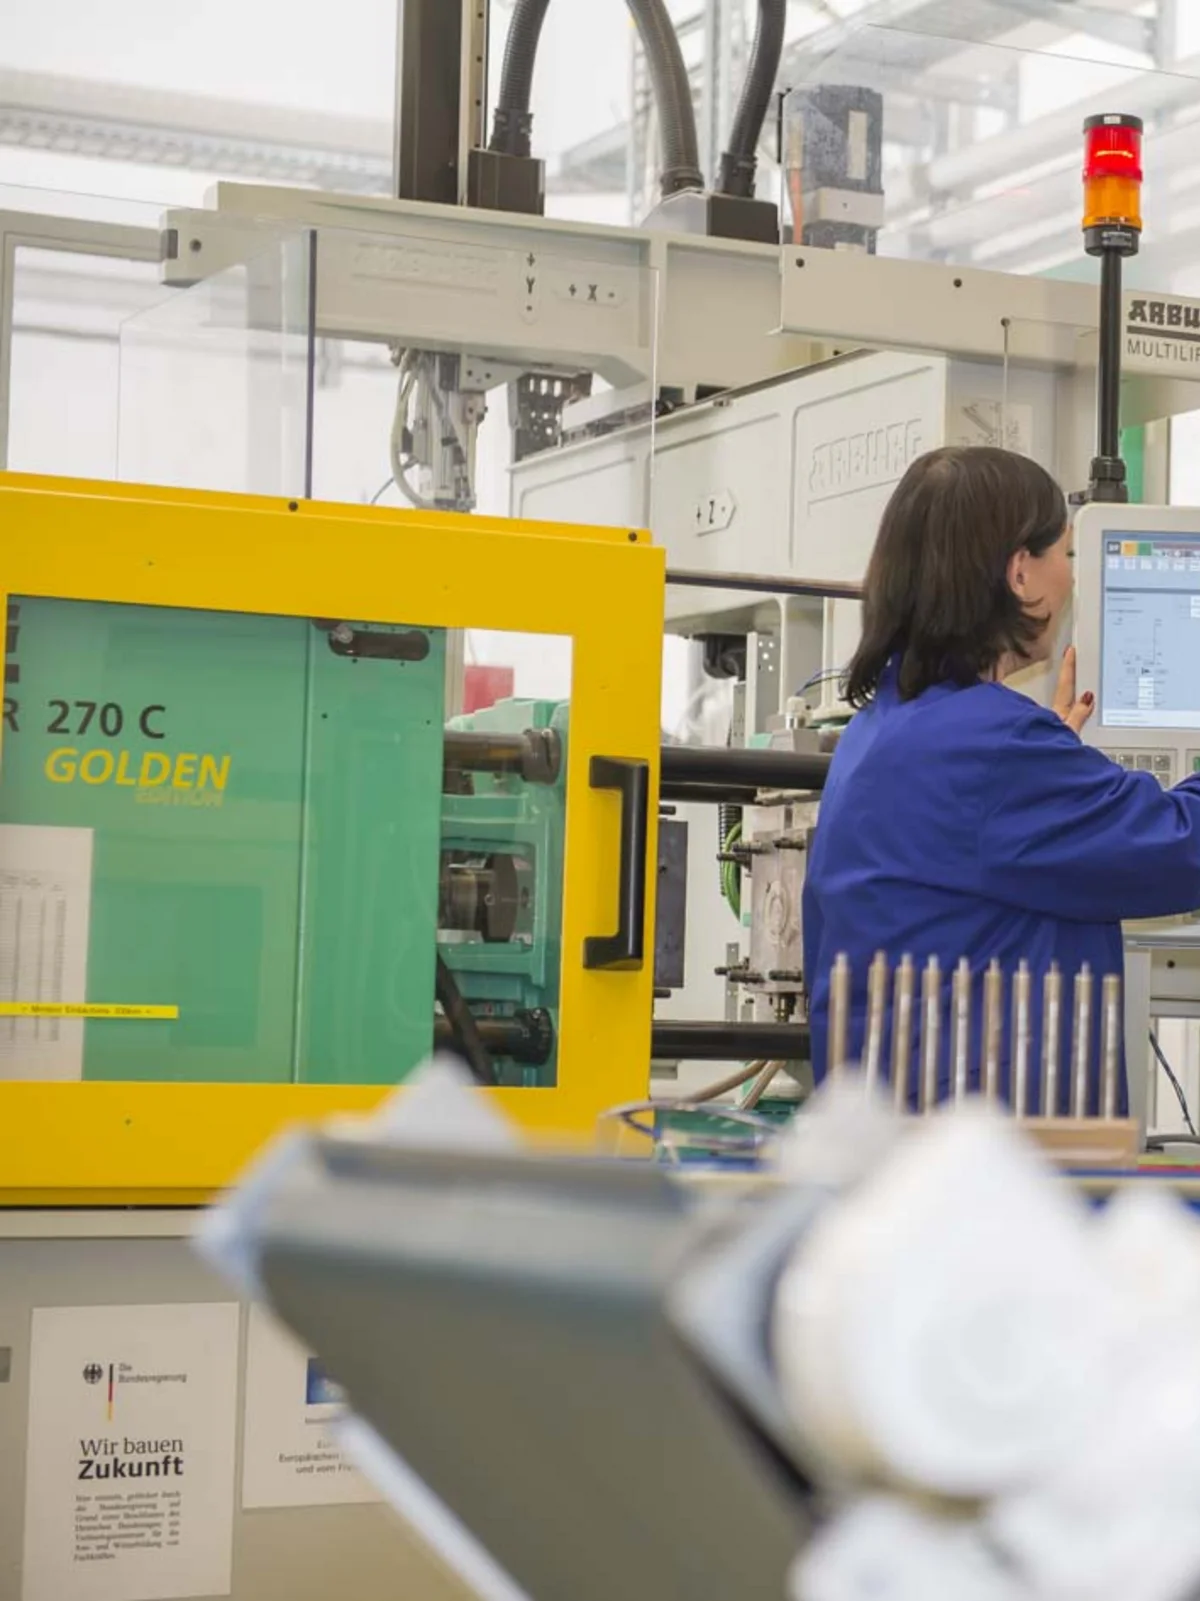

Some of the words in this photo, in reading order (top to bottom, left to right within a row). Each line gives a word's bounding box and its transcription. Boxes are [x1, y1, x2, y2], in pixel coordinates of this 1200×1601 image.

[47, 700, 123, 737] 270
[139, 705, 166, 739] C
[44, 747, 232, 793] GOLDEN
[80, 1439, 118, 1456] Wir
[123, 1437, 183, 1454] bauen
[78, 1455, 184, 1480] Zukunft
